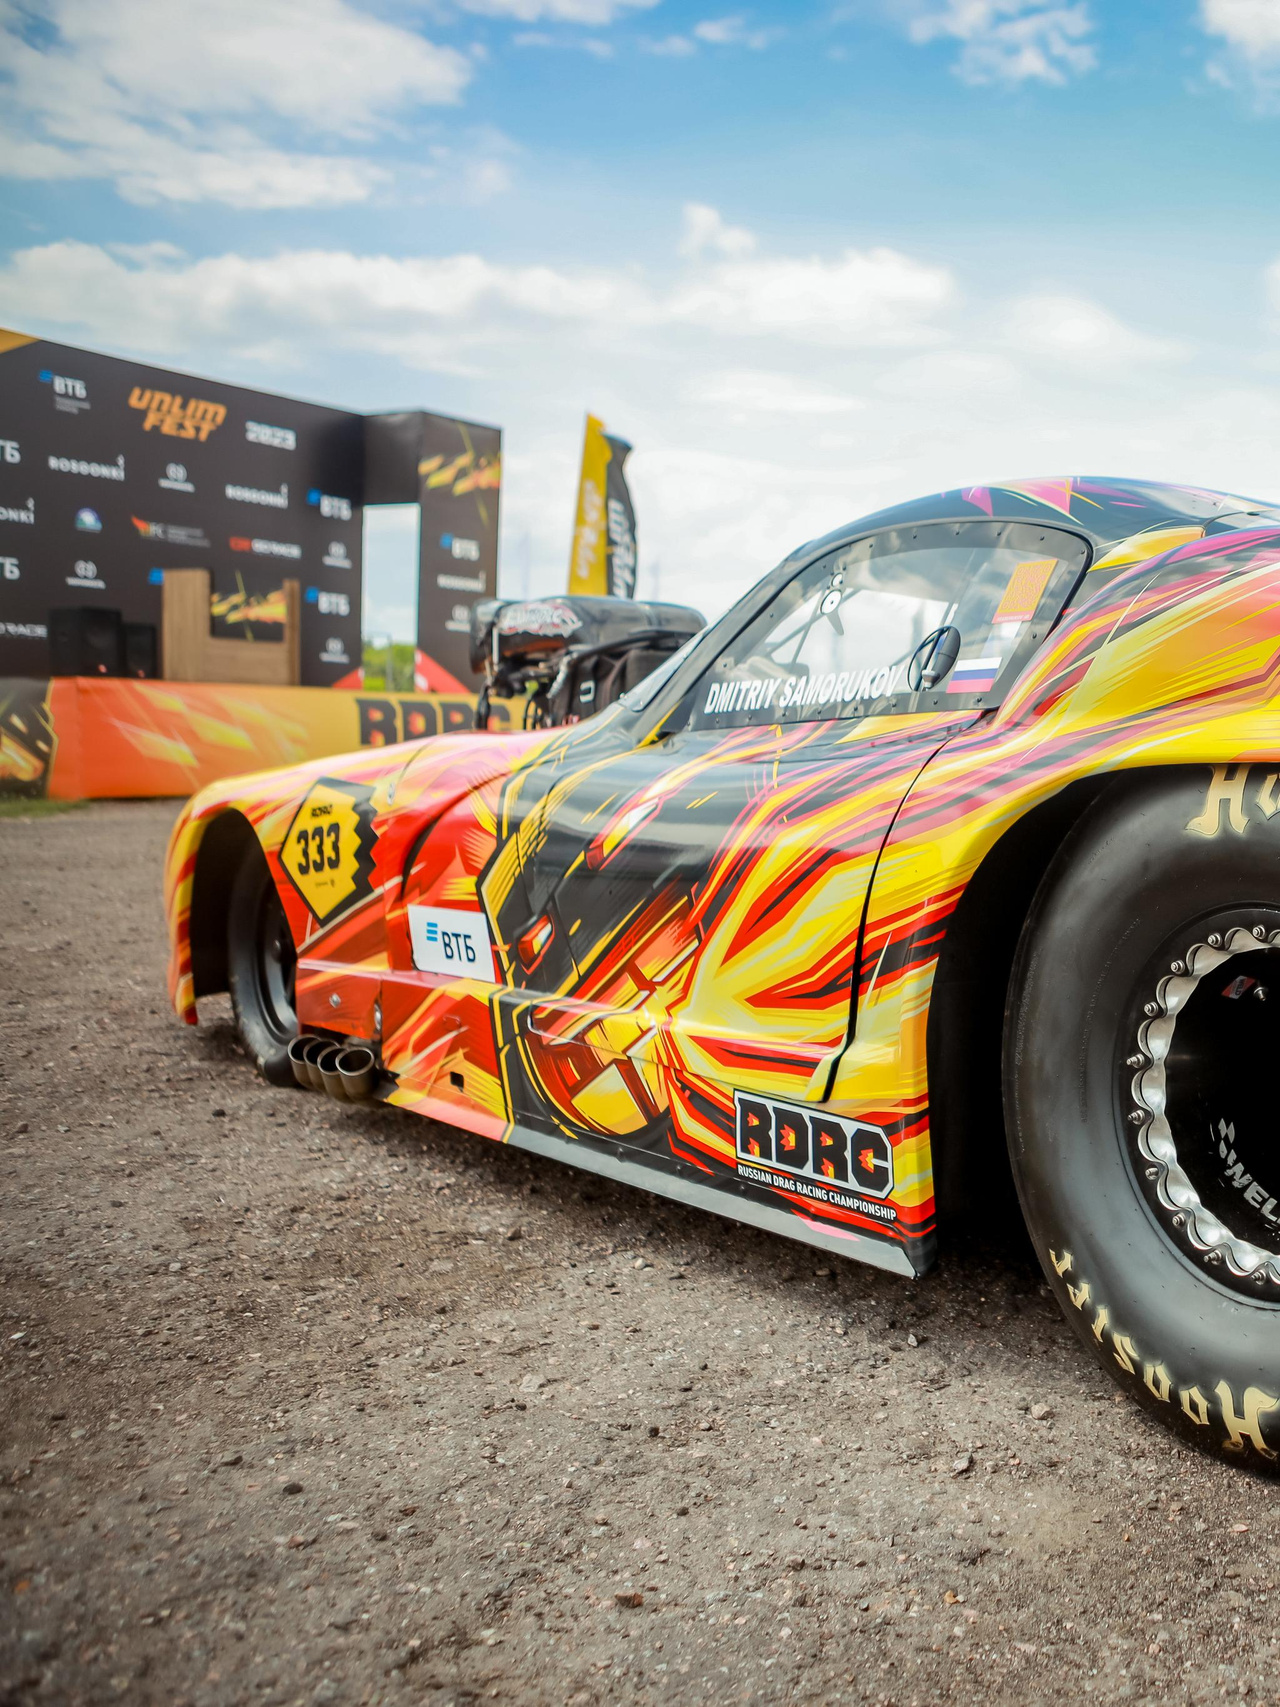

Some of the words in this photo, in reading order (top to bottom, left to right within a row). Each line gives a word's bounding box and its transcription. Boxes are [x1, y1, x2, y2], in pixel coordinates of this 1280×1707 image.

[53, 375, 87, 398] ВТБ
[128, 386, 227, 426] UNLIM
[143, 411, 217, 442] FEST
[320, 494, 352, 521] ВТБ
[452, 537, 480, 561] ВТБ
[318, 591, 350, 616] ВТБ
[704, 678, 782, 714] DMITRIY
[779, 665, 905, 708] SAMORUKOV
[297, 823, 340, 875] 333
[441, 931, 476, 963] ВТБ
[737, 1096, 890, 1193] RDRC
[737, 1164, 772, 1185] RUSSIAN
[773, 1176, 796, 1191] DRAG
[796, 1184, 828, 1201] RACING
[828, 1192, 897, 1221] CHAMPIONSHIP
